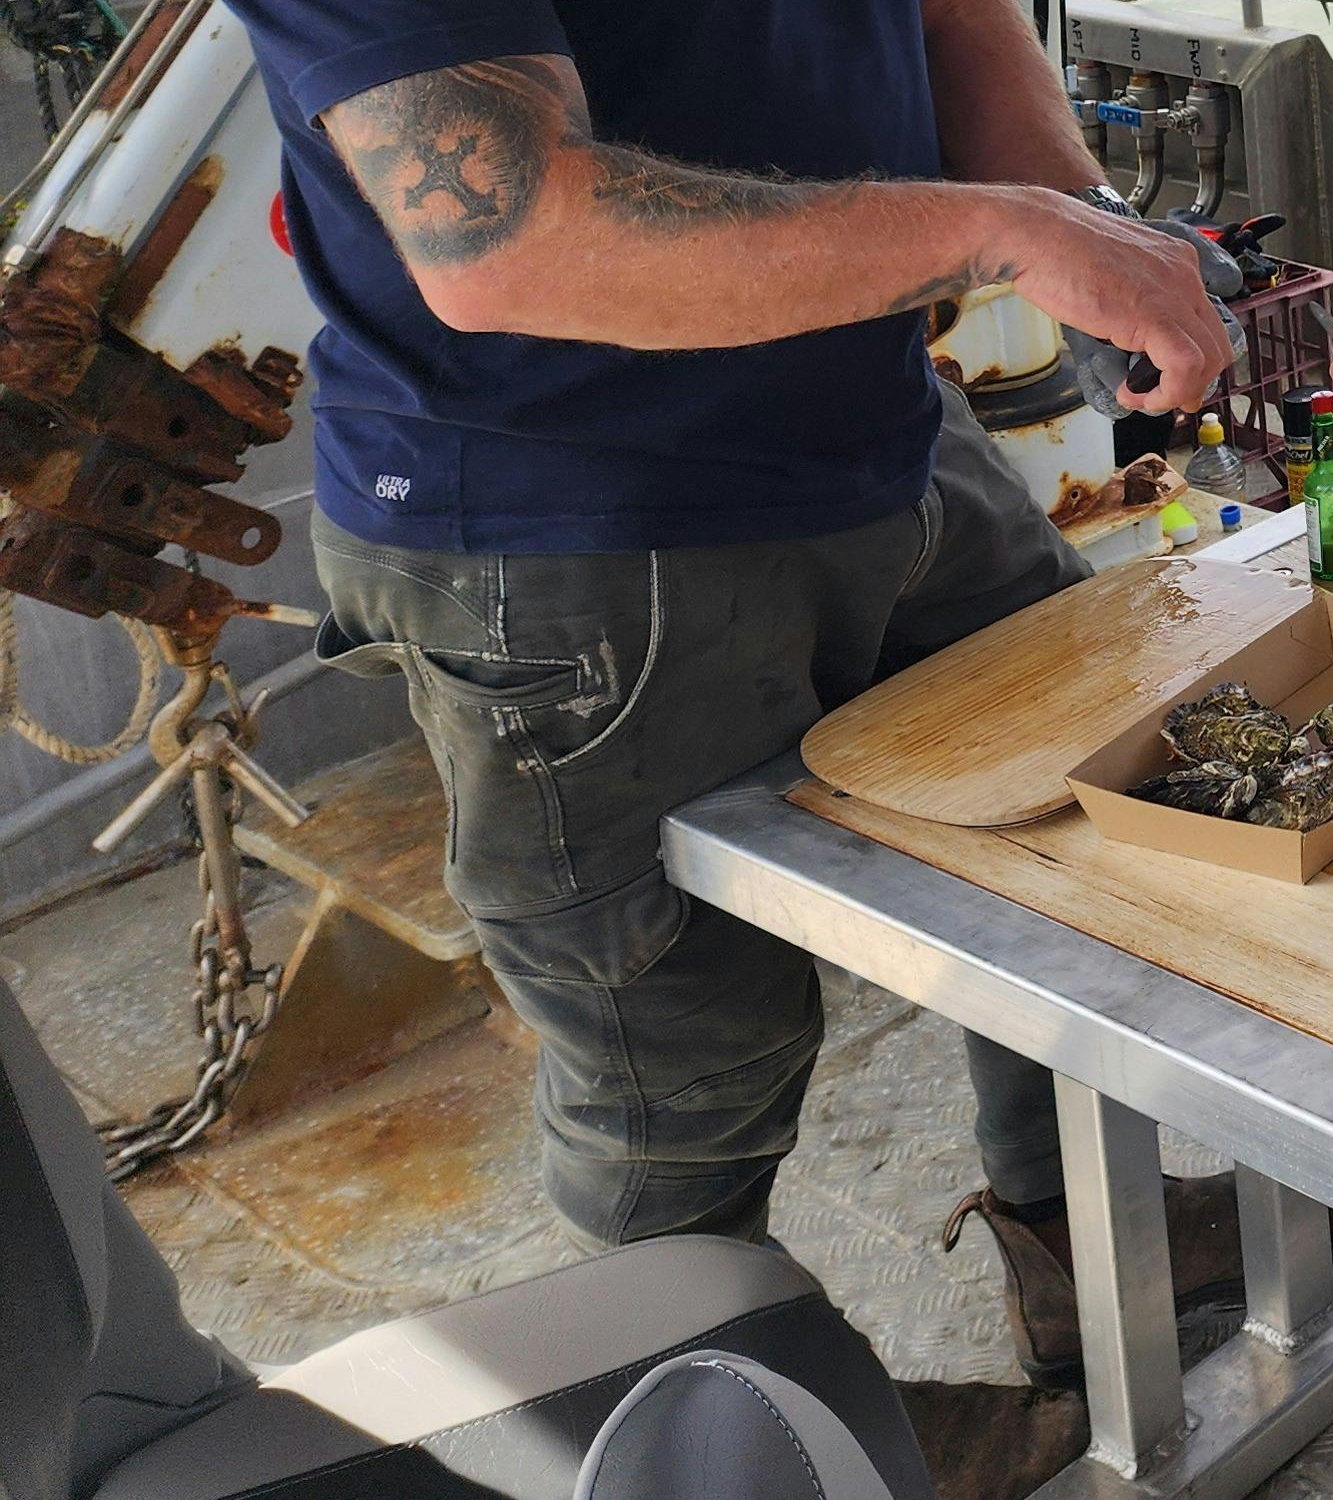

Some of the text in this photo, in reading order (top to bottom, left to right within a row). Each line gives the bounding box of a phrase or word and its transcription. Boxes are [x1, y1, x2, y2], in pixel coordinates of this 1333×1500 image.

[1070, 18, 1084, 54] AFT
[1129, 27, 1141, 61] MID
[1187, 39, 1201, 77] FWD
[377, 474, 411, 488] ULTRA
